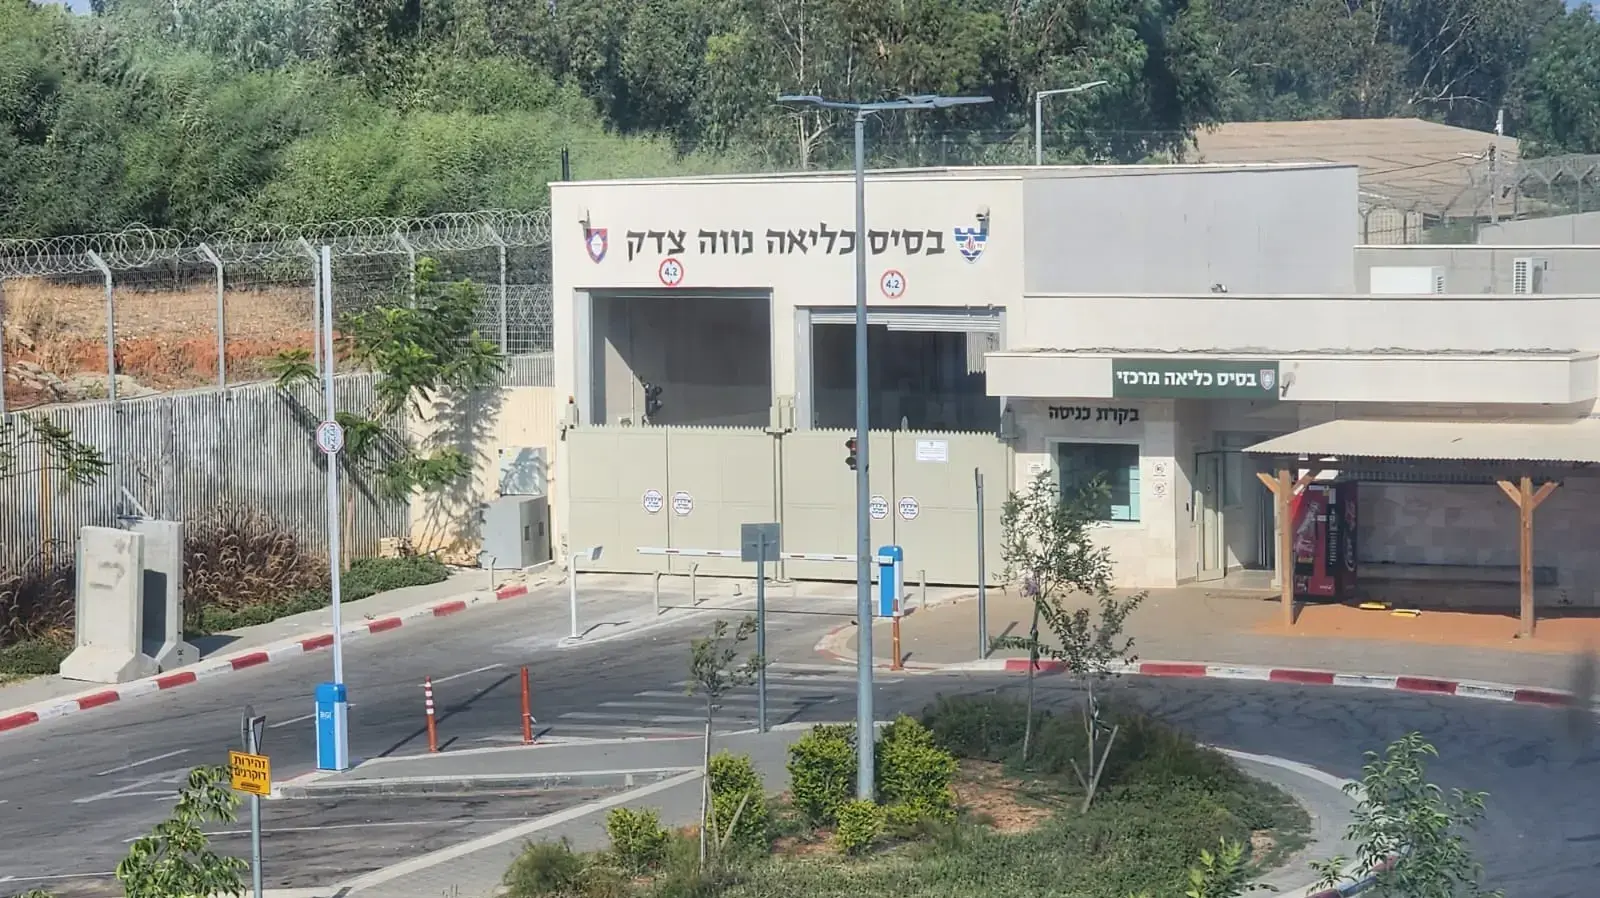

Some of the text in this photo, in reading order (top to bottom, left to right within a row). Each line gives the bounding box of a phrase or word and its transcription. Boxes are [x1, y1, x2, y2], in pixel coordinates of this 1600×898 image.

[627, 222, 945, 262] בסיס כליאה נווה צדק
[664, 267, 678, 276] 4.2
[886, 279, 900, 289] 4.2
[1116, 369, 1257, 387] בסיס כליאה מרכזי
[1048, 405, 1139, 425] בקרת כניסה
[234, 756, 265, 768] זהירות
[234, 767, 266, 780] דוקרנים
